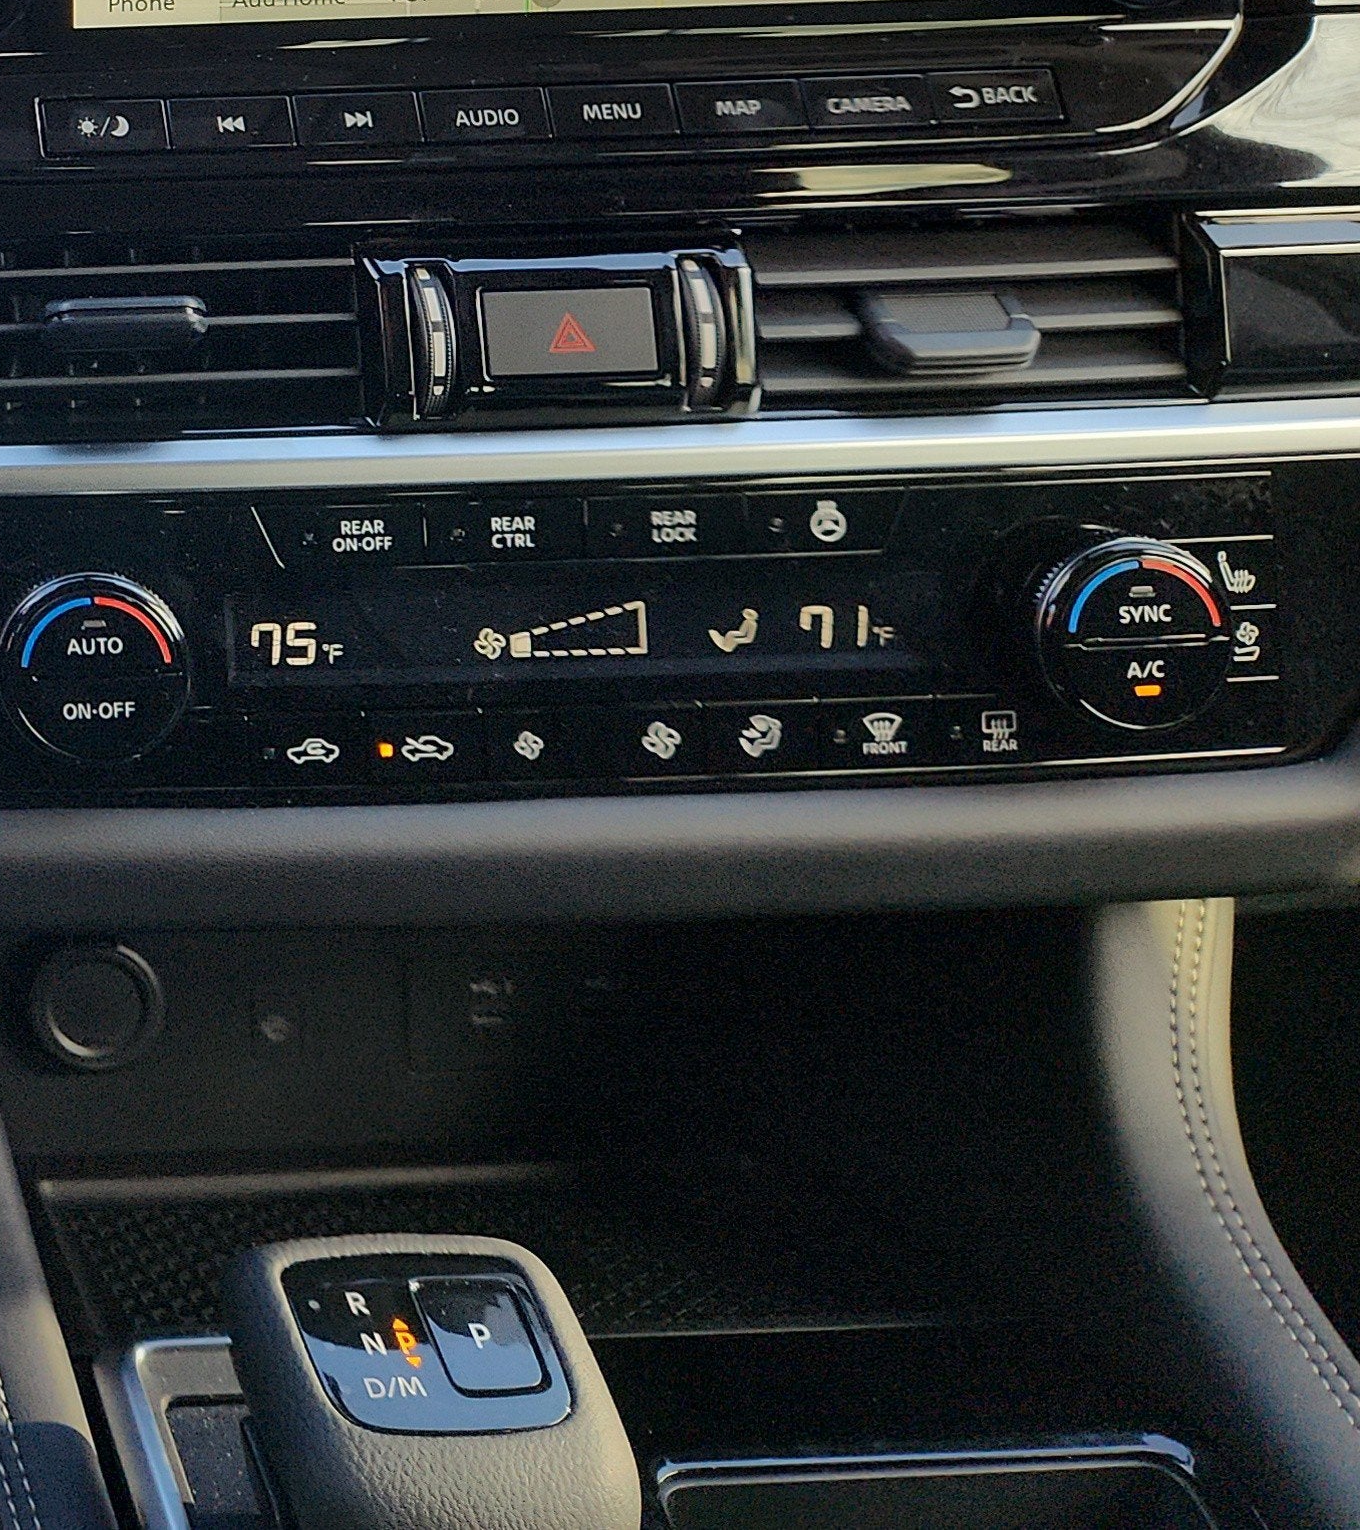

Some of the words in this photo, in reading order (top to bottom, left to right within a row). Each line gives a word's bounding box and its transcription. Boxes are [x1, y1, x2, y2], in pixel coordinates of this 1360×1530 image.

[826, 95, 912, 116] CAMERA
[981, 84, 1038, 107] BACK
[454, 107, 520, 129] AUDIO
[582, 101, 643, 123] MENU
[713, 97, 762, 118] MAP
[340, 520, 385, 535] REAR
[490, 516, 535, 532] REAR
[650, 511, 697, 527] REAR
[490, 532, 535, 549] CTRL
[651, 527, 698, 543] LOCK
[1118, 602, 1172, 625] SYNC
[66, 636, 124, 657] AUTO
[1127, 659, 1166, 680] A/C
[862, 739, 908, 755] FRONT
[982, 737, 1019, 753] REAR
[344, 1291, 372, 1317] R
[360, 1331, 388, 1356] N
[395, 1332, 419, 1355] P
[467, 1321, 492, 1350] P
[362, 1374, 429, 1400] D/M
